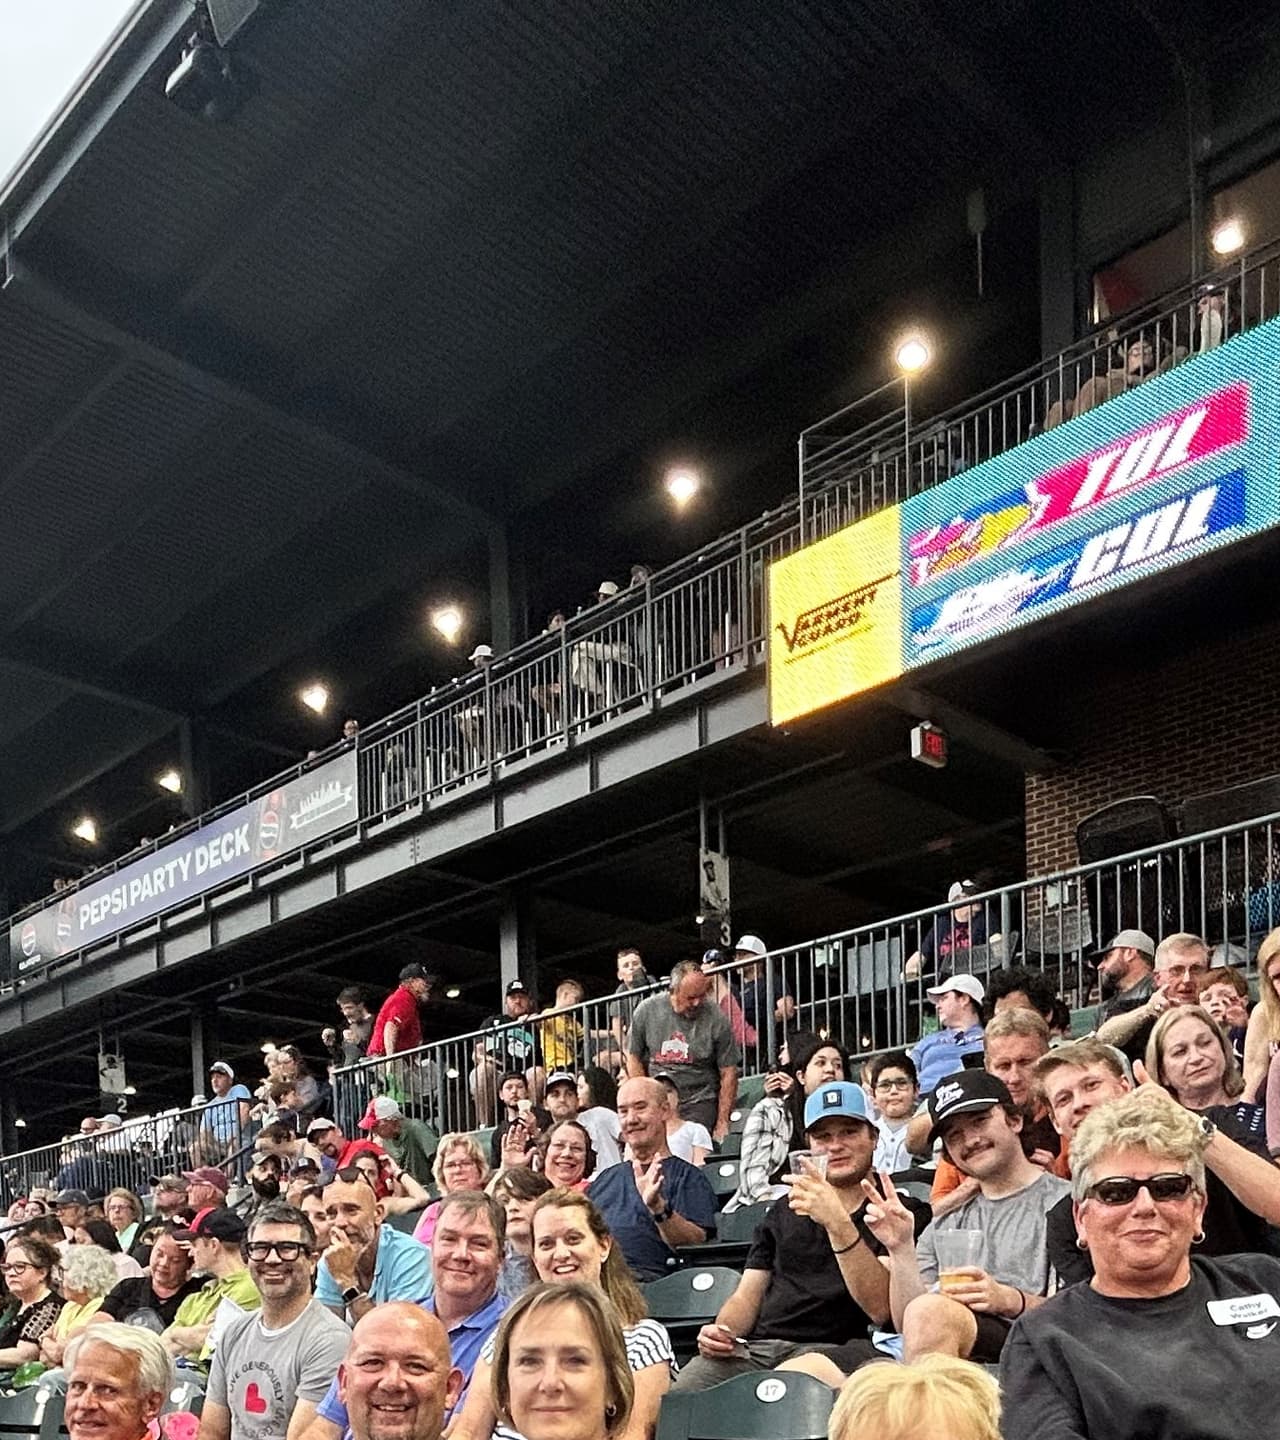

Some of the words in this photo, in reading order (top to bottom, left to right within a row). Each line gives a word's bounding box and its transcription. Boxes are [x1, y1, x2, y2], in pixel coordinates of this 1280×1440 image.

[1069, 403, 1209, 510] TOL
[1068, 483, 1219, 591] COL
[79, 884, 128, 931] PEPSI
[129, 852, 193, 907] PARTY
[195, 823, 251, 876] DECK
[1229, 1301, 1262, 1312] Cathy
[764, 1384, 779, 1397] 17
